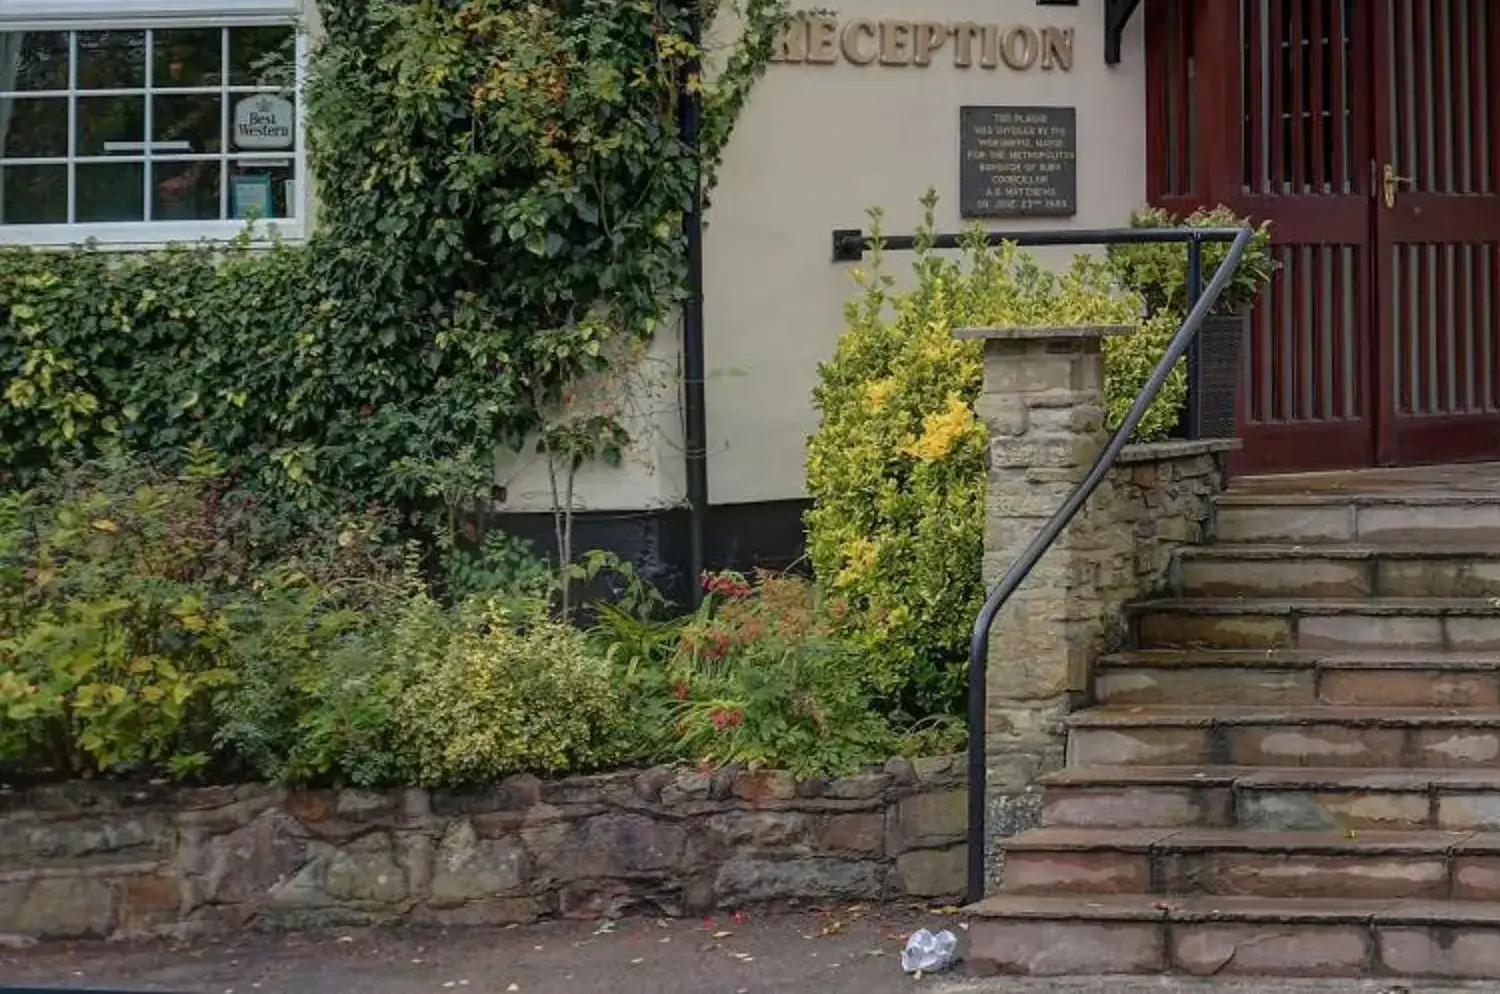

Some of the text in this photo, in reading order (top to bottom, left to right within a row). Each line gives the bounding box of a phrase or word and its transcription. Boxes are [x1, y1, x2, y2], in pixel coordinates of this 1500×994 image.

[768, 17, 1075, 71] RECEPTION
[249, 111, 277, 125] Best
[239, 124, 289, 137] Western
